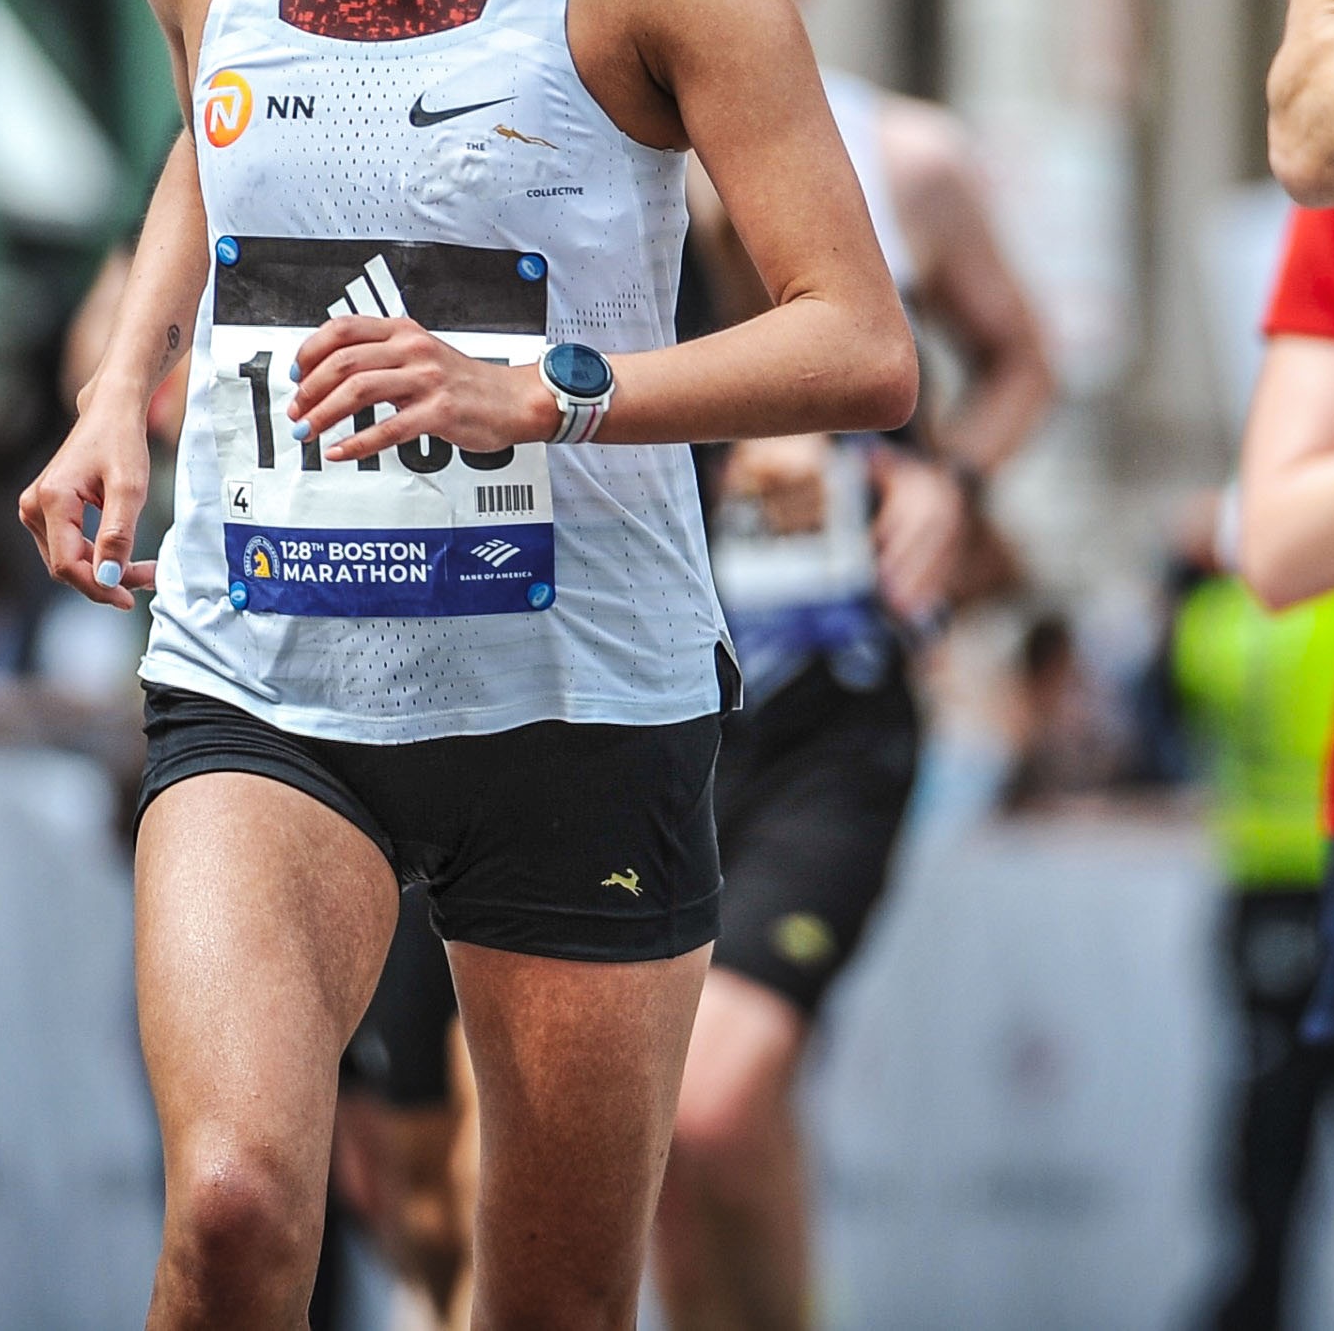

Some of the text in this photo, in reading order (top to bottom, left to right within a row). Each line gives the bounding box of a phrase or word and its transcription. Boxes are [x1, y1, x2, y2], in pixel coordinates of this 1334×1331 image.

[267, 96, 315, 119] NN
[466, 142, 485, 151] THE
[526, 187, 584, 198] COLLECTIVE
[233, 487, 248, 513] 4
[280, 541, 325, 560] 128TH
[328, 542, 426, 561] BOSTON
[496, 571, 533, 579] AMERICA
